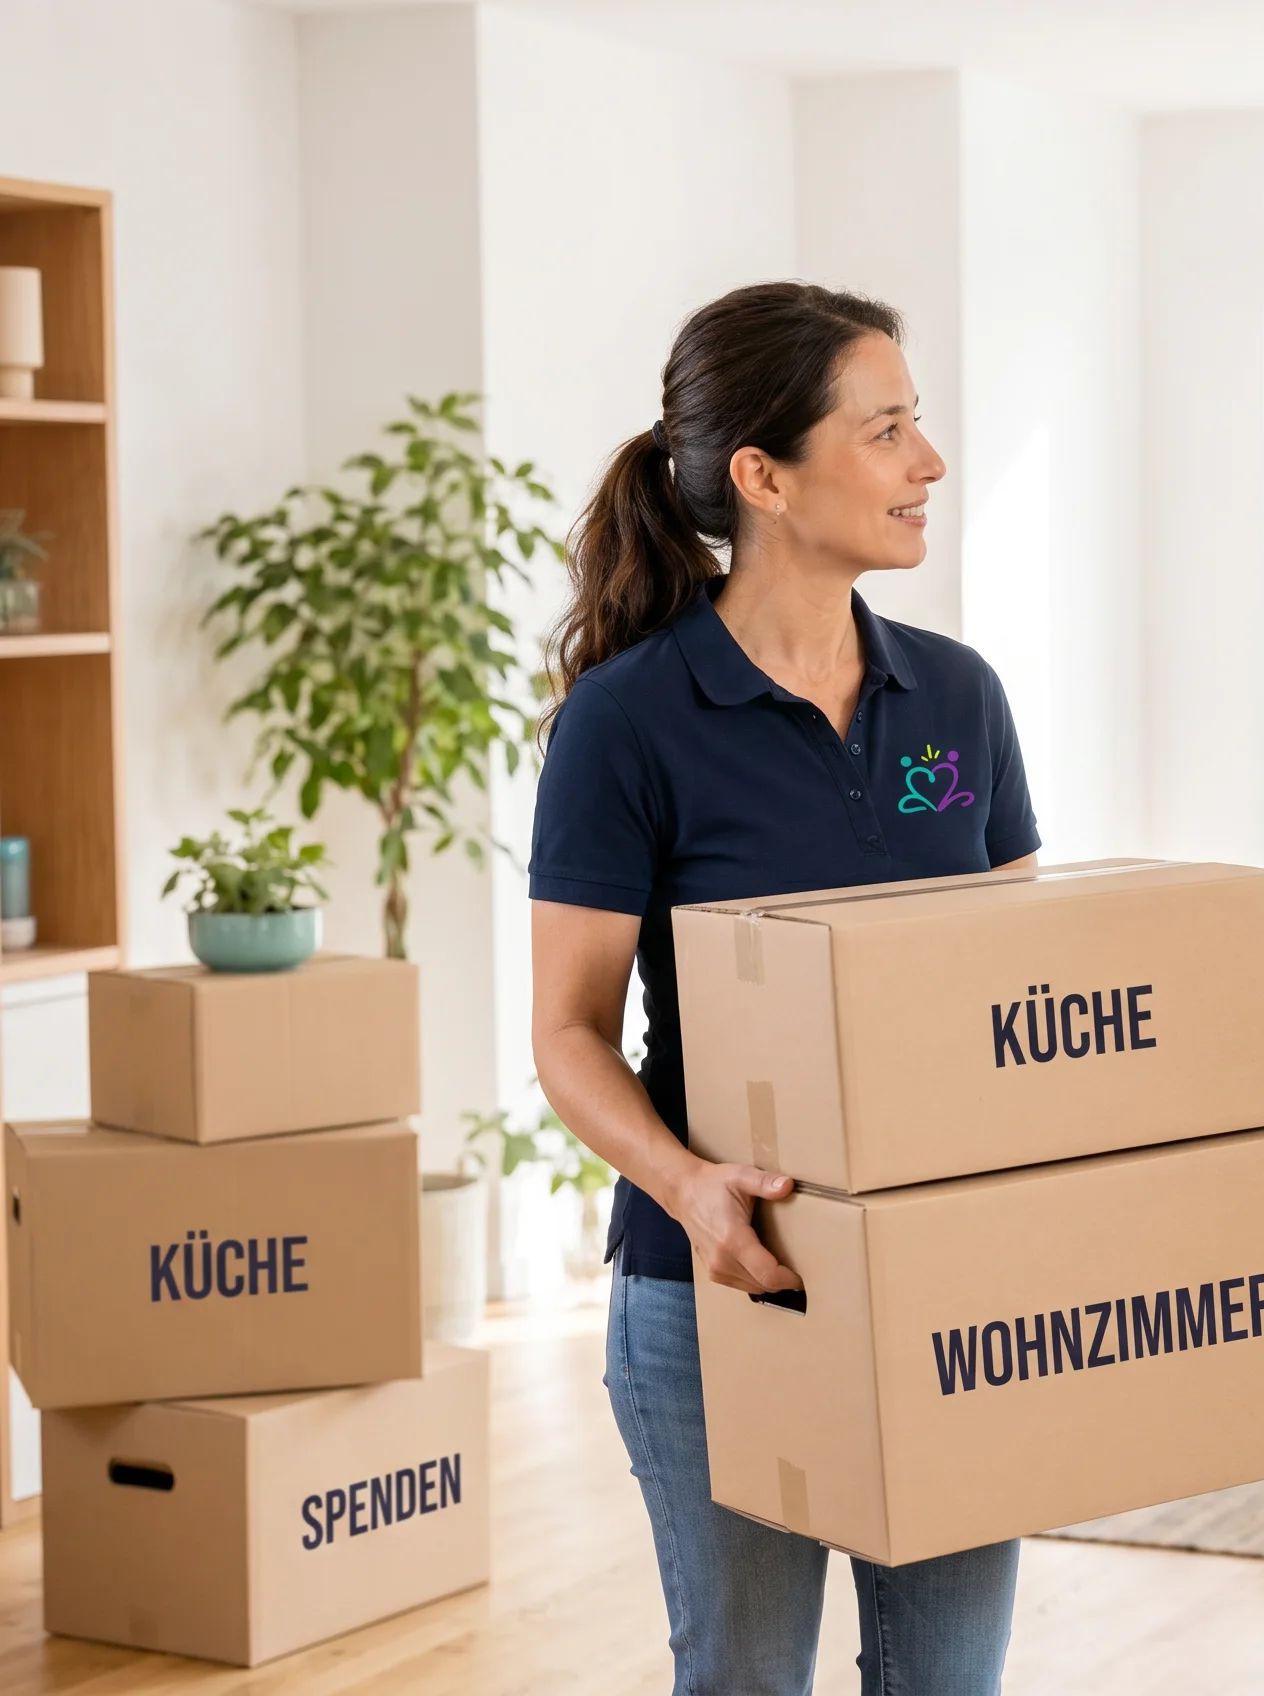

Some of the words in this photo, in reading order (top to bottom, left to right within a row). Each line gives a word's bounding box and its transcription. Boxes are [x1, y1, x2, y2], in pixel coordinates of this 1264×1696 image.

[991, 983, 1157, 1069] KÜCHE
[150, 1229, 309, 1303] KÜCHE
[301, 1453, 462, 1550] SPENDEN
